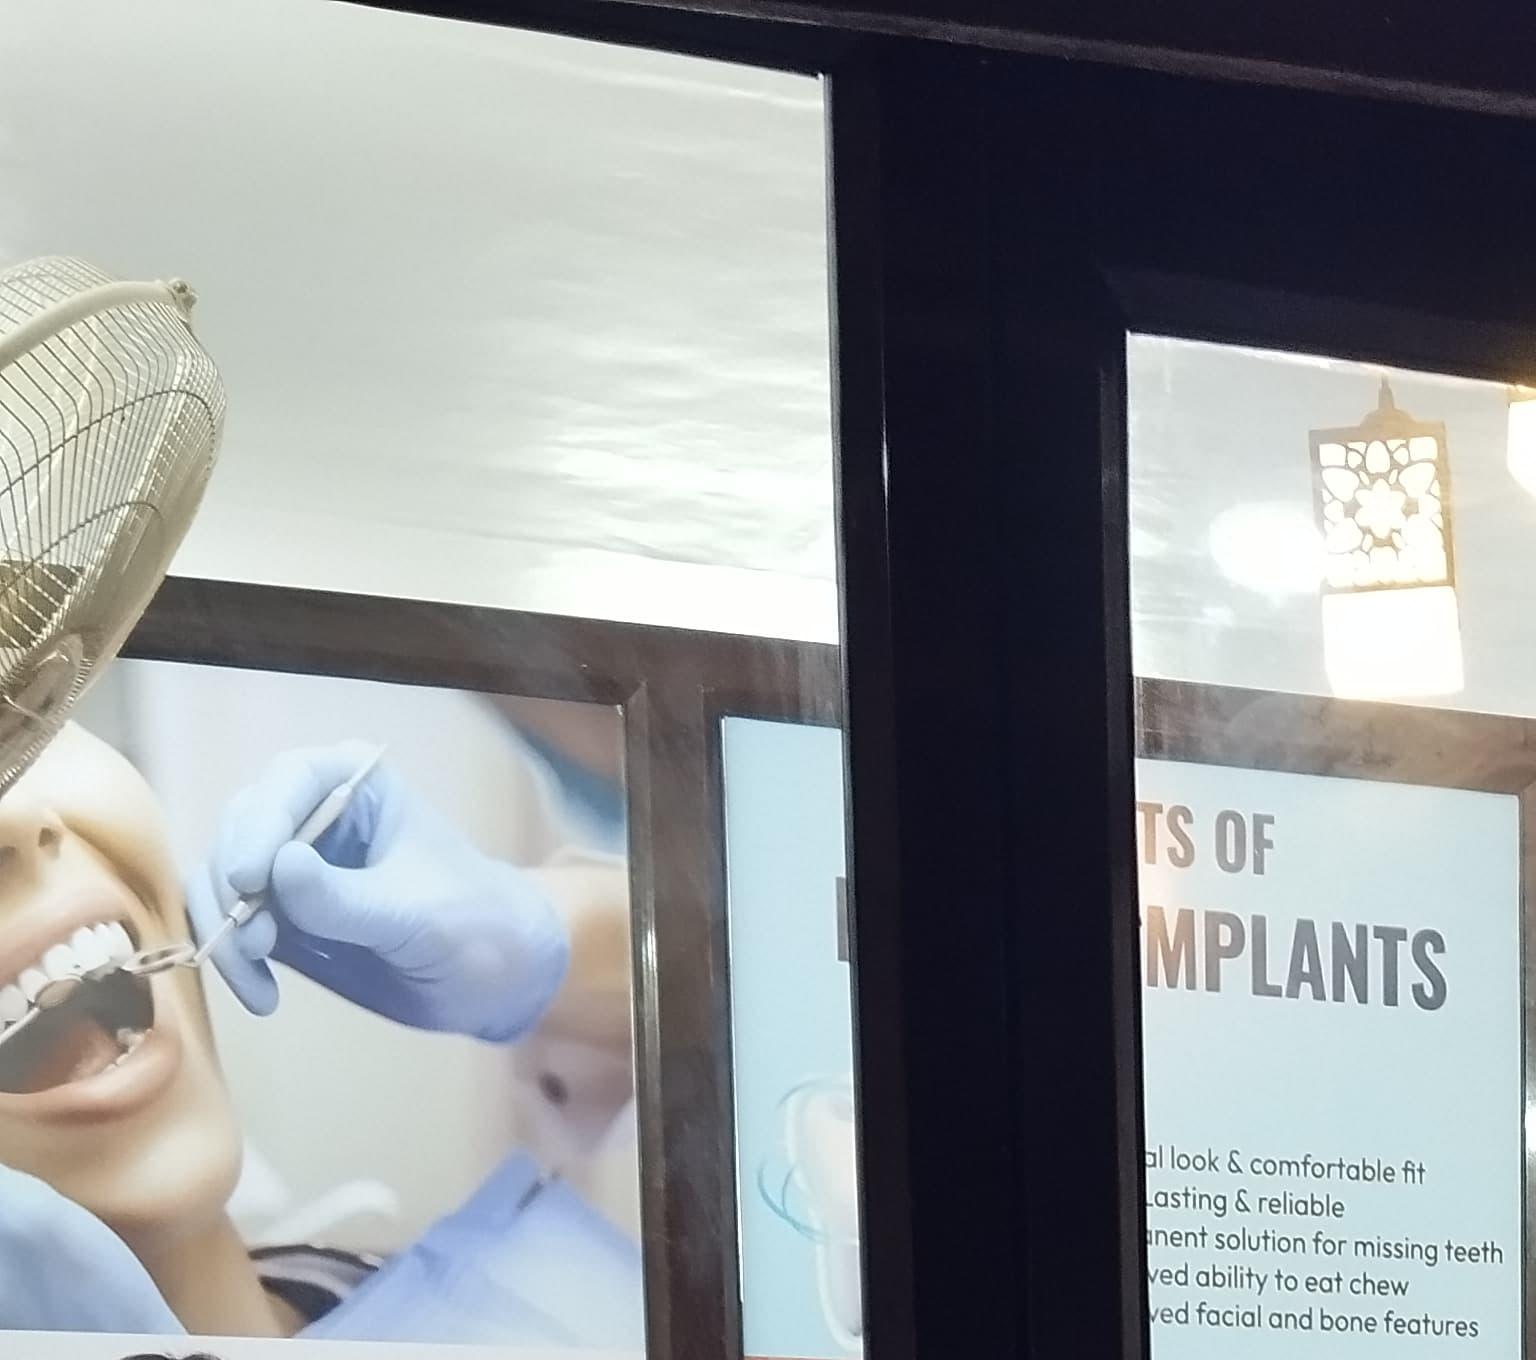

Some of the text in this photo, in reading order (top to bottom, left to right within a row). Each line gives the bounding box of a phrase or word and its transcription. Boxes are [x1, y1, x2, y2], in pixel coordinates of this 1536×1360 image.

[1137, 801, 1275, 876] TS OF
[1146, 904, 1447, 1011] MPLANTS
[1145, 1144, 1426, 1185] al look & comfortable fit
[1146, 1185, 1345, 1218] asting & reliable
[1147, 1224, 1504, 1268] nent solution for missing teeth
[1147, 1261, 1410, 1297] ved ability to eat chew
[1149, 1300, 1480, 1338] ved facial and bone features
